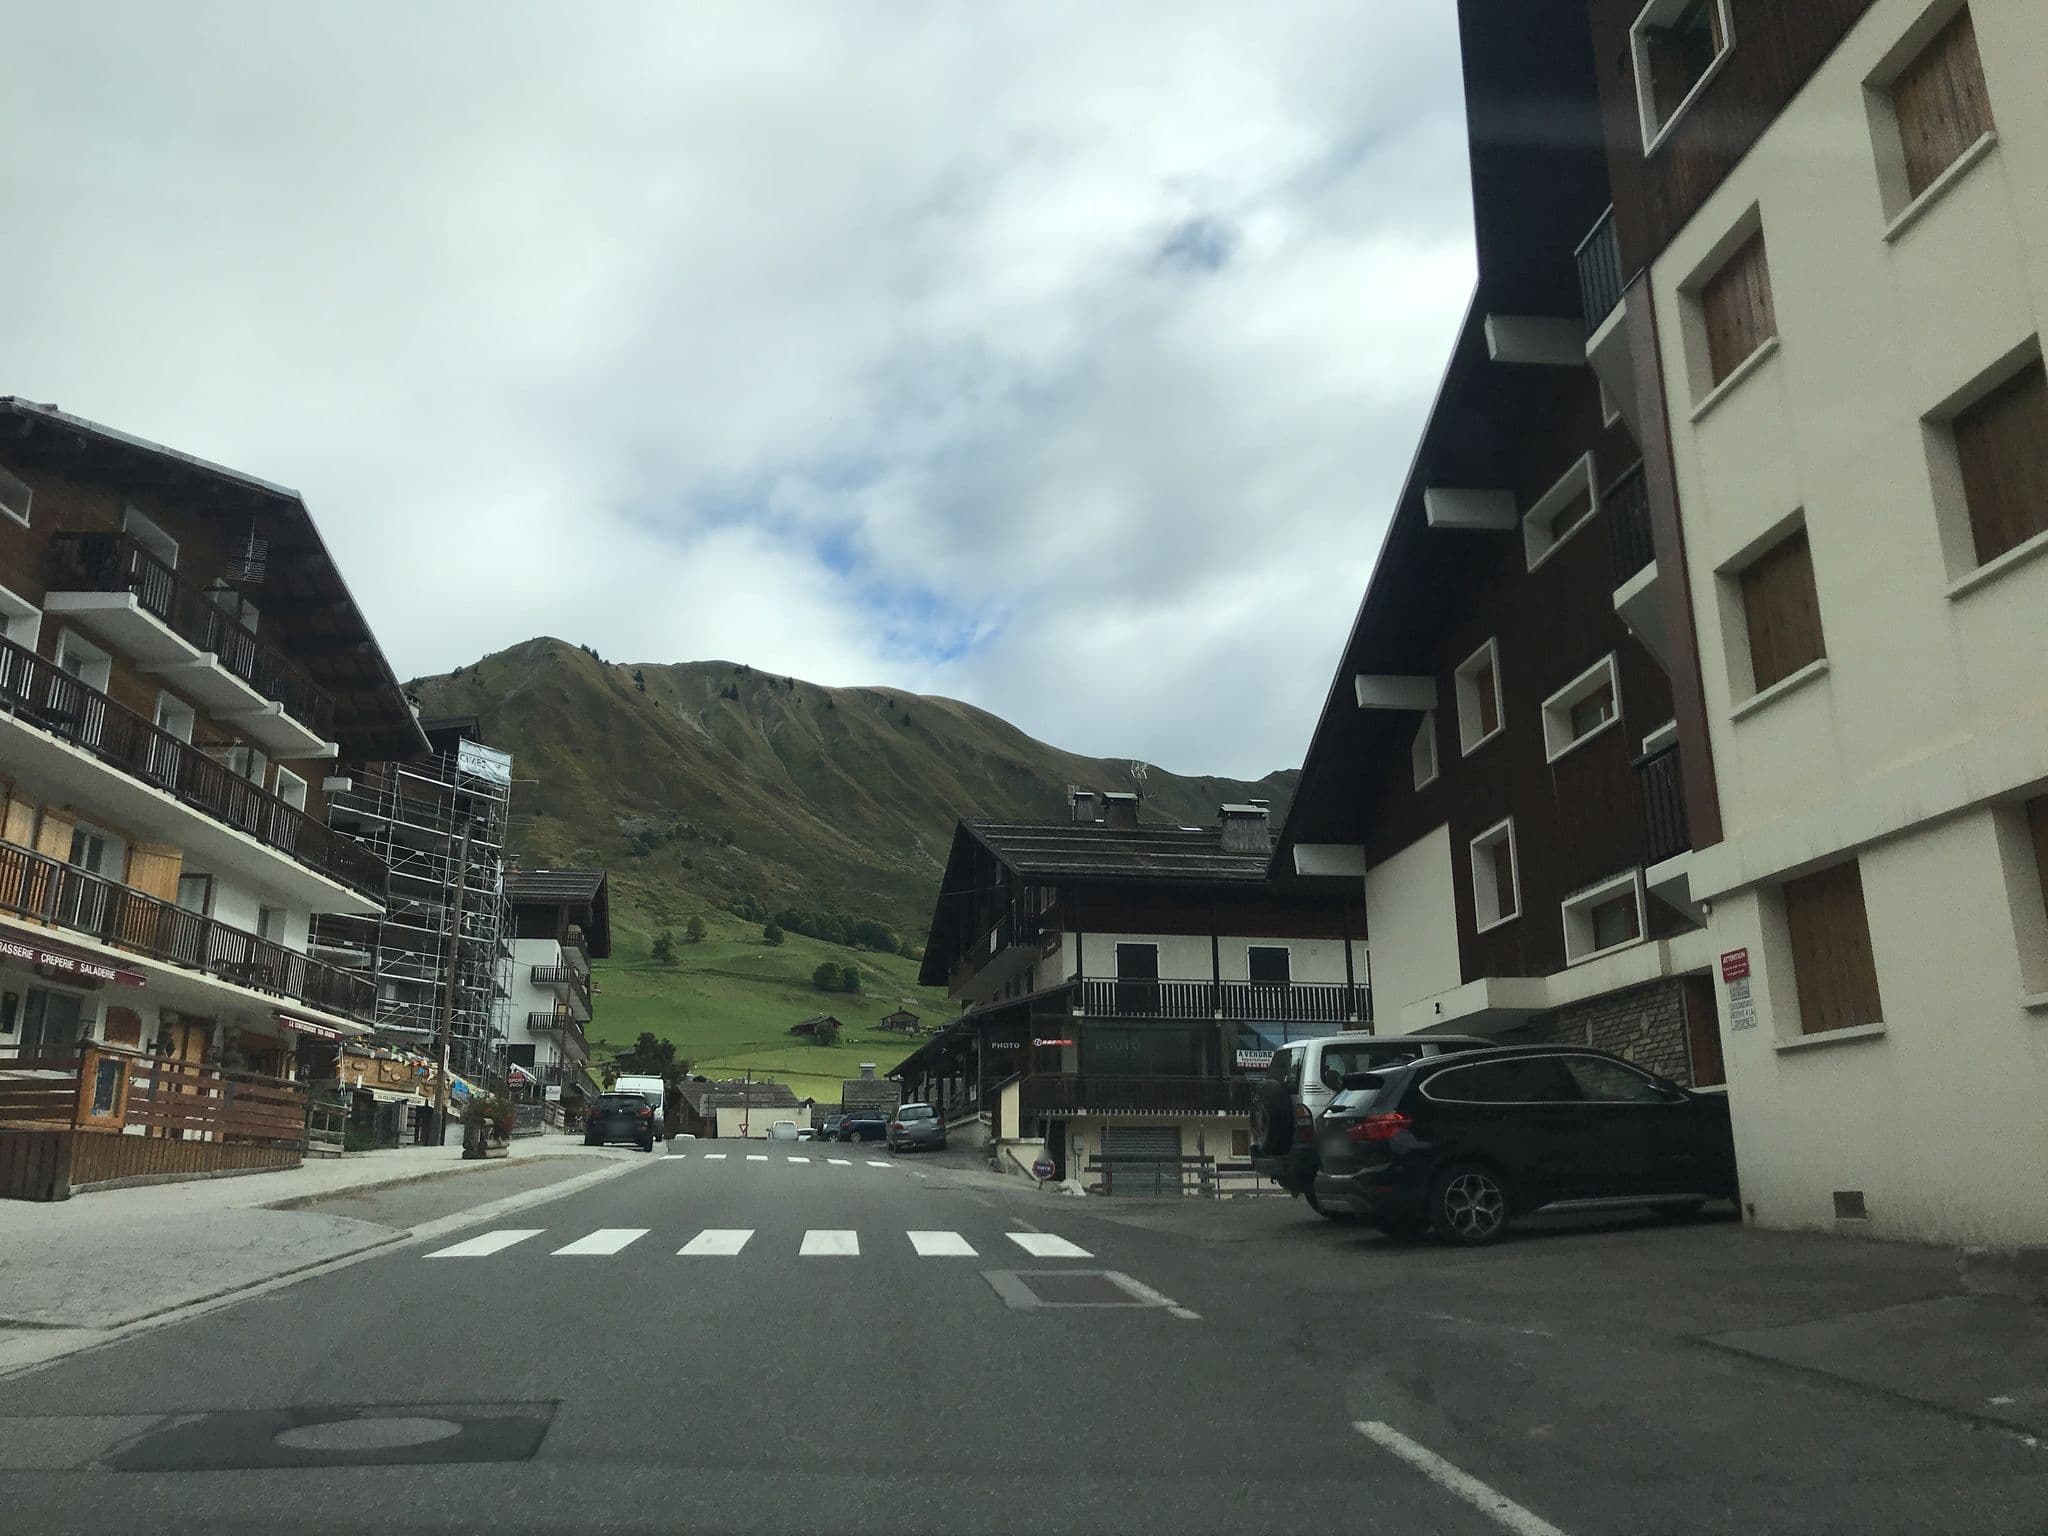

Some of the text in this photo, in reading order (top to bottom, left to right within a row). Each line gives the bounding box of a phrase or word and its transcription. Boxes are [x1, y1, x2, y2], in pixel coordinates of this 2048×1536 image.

[1722, 951, 1746, 964] ATTENTION
[41, 952, 75, 970] CREPERIE
[80, 963, 116, 980] SALADERIE
[1434, 1002, 1441, 1015] 2
[1238, 1050, 1273, 1058] A VENDRE
